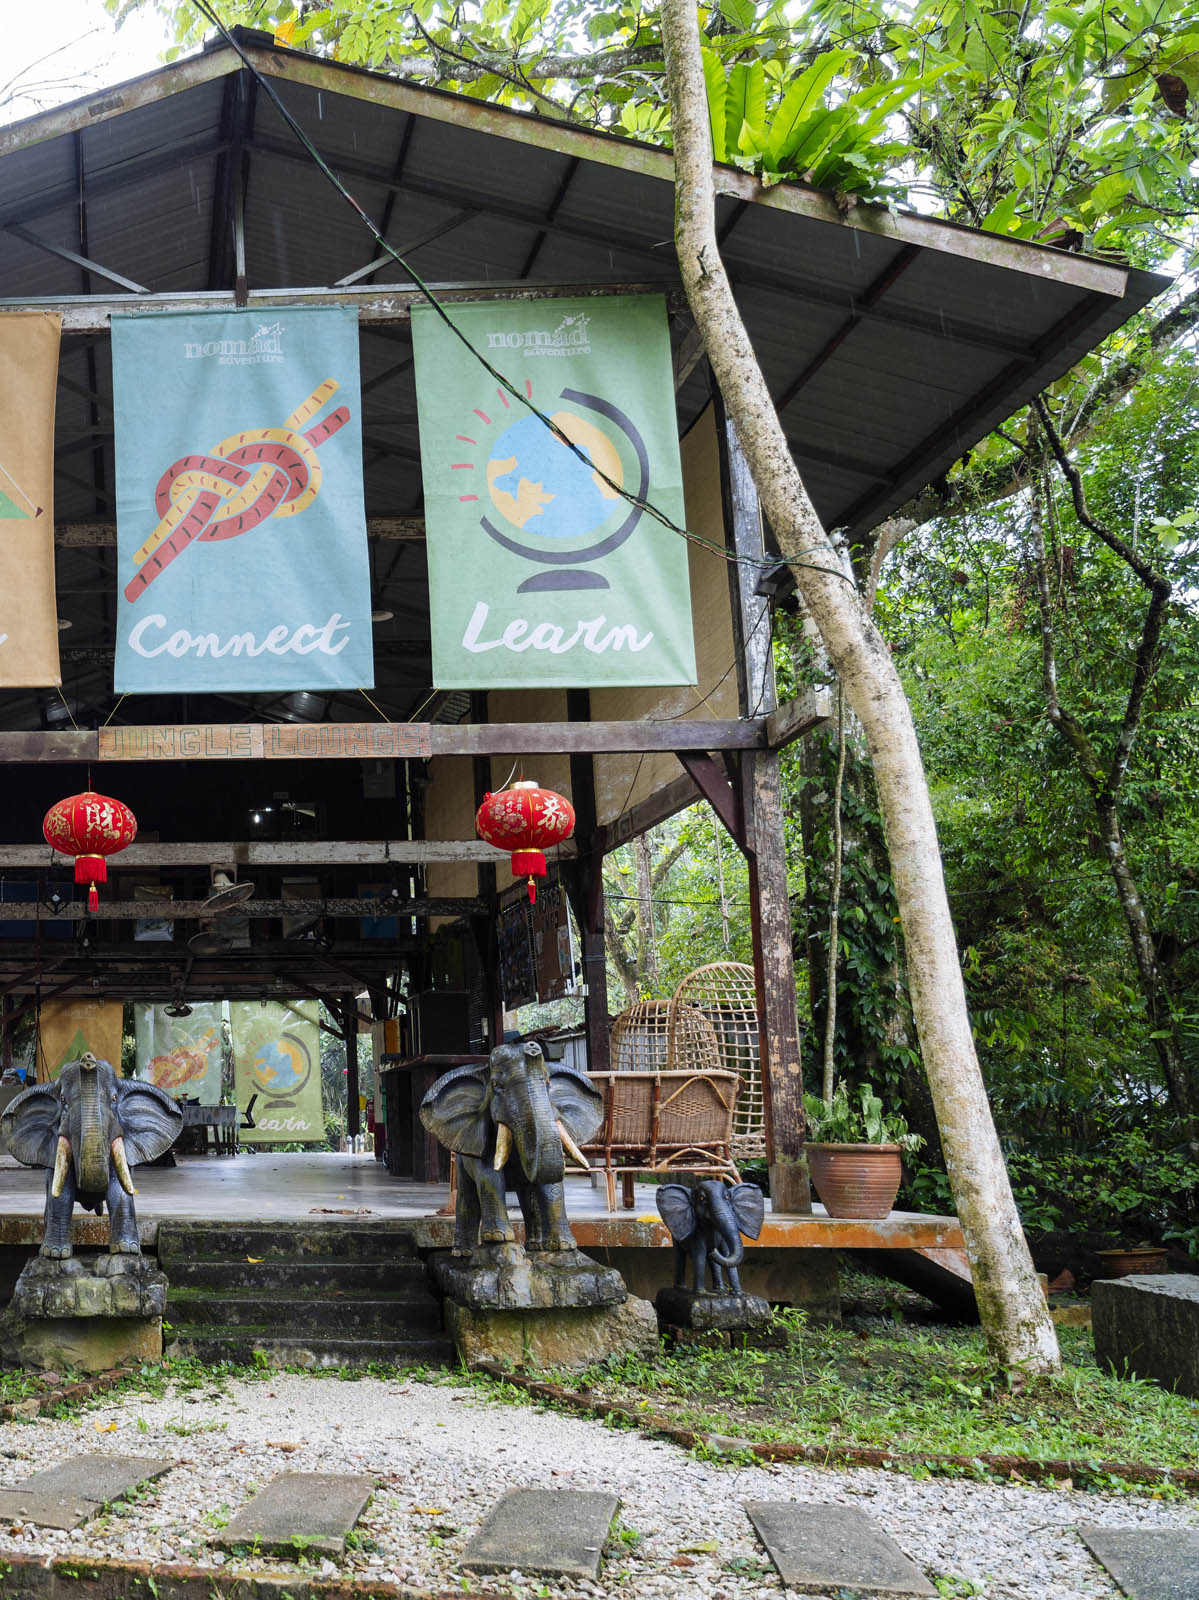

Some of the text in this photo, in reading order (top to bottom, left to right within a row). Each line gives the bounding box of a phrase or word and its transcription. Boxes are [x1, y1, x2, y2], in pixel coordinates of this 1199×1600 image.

[183, 332, 283, 359] nomad
[485, 321, 591, 348] nomad
[523, 346, 591, 357] adventure
[128, 613, 351, 658] Connect
[462, 601, 654, 653] Learn
[104, 726, 423, 758] JUNGLE LOUNGE
[257, 1116, 311, 1131] earn
